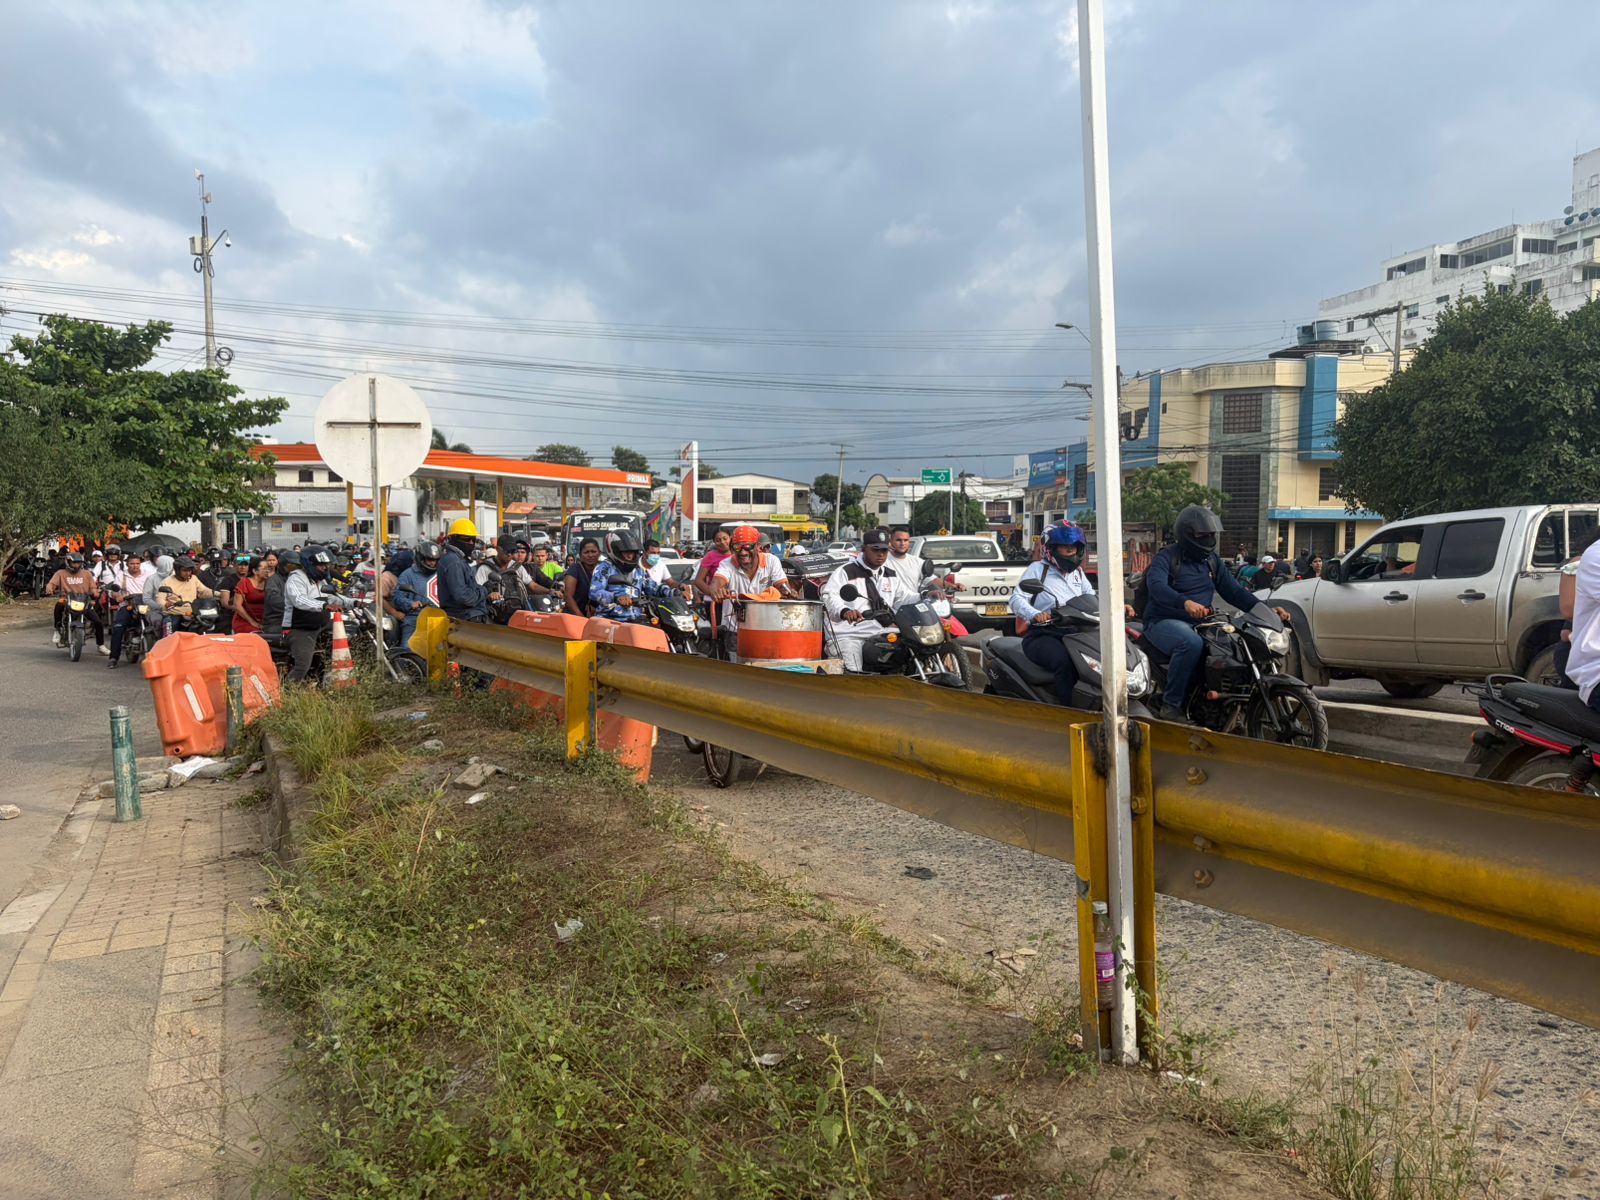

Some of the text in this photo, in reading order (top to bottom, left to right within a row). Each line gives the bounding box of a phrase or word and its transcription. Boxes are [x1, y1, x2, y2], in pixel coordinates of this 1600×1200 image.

[627, 473, 649, 485] PRIMAX
[972, 586, 1015, 596] TOYOT
[1495, 719, 1515, 734] CT100
